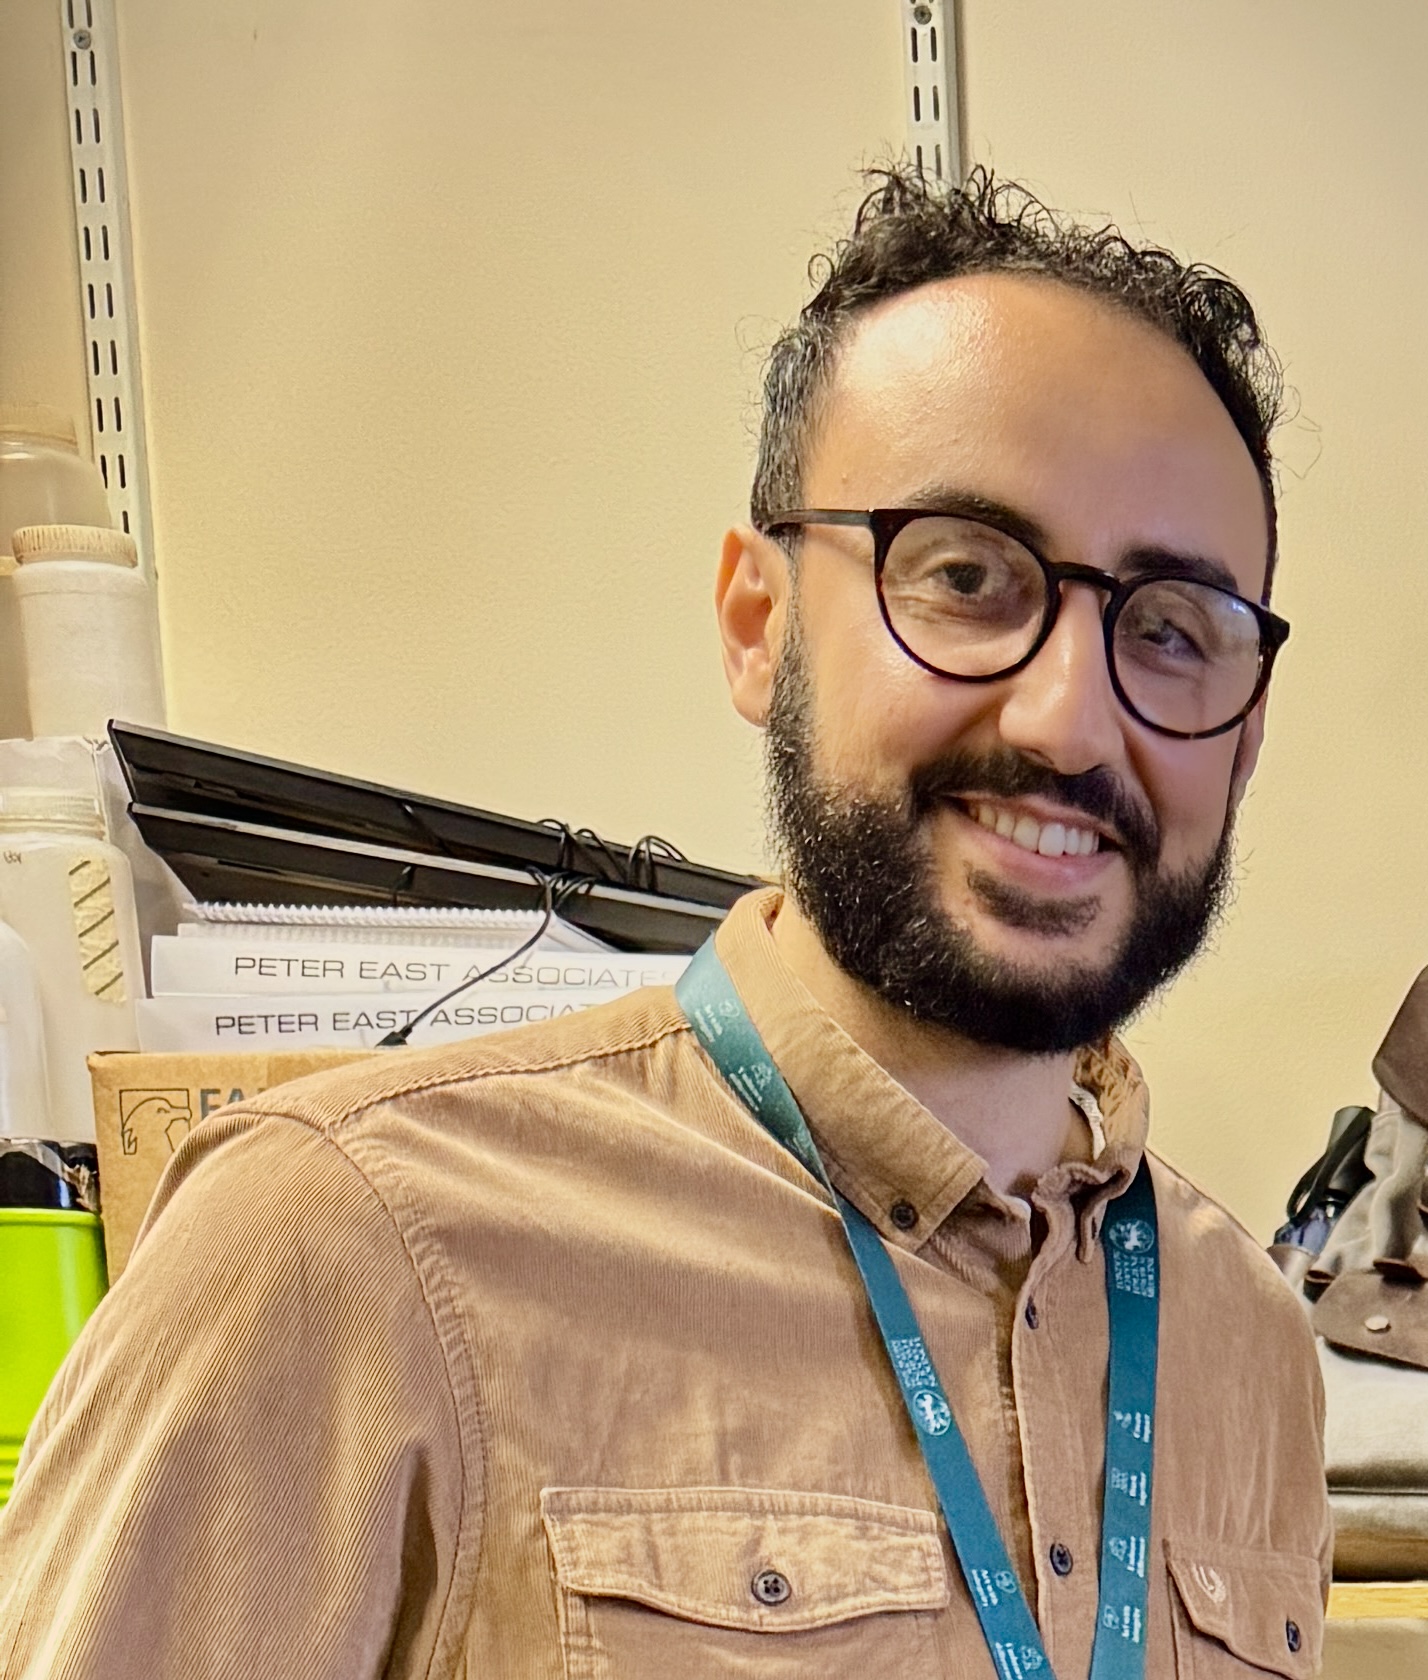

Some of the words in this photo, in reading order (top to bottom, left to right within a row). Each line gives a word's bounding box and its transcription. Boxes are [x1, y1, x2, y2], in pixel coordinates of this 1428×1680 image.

[235, 957, 344, 979] PETER
[359, 961, 450, 981] EAST
[215, 1013, 318, 1035] PETER
[333, 1010, 418, 1031] EAST
